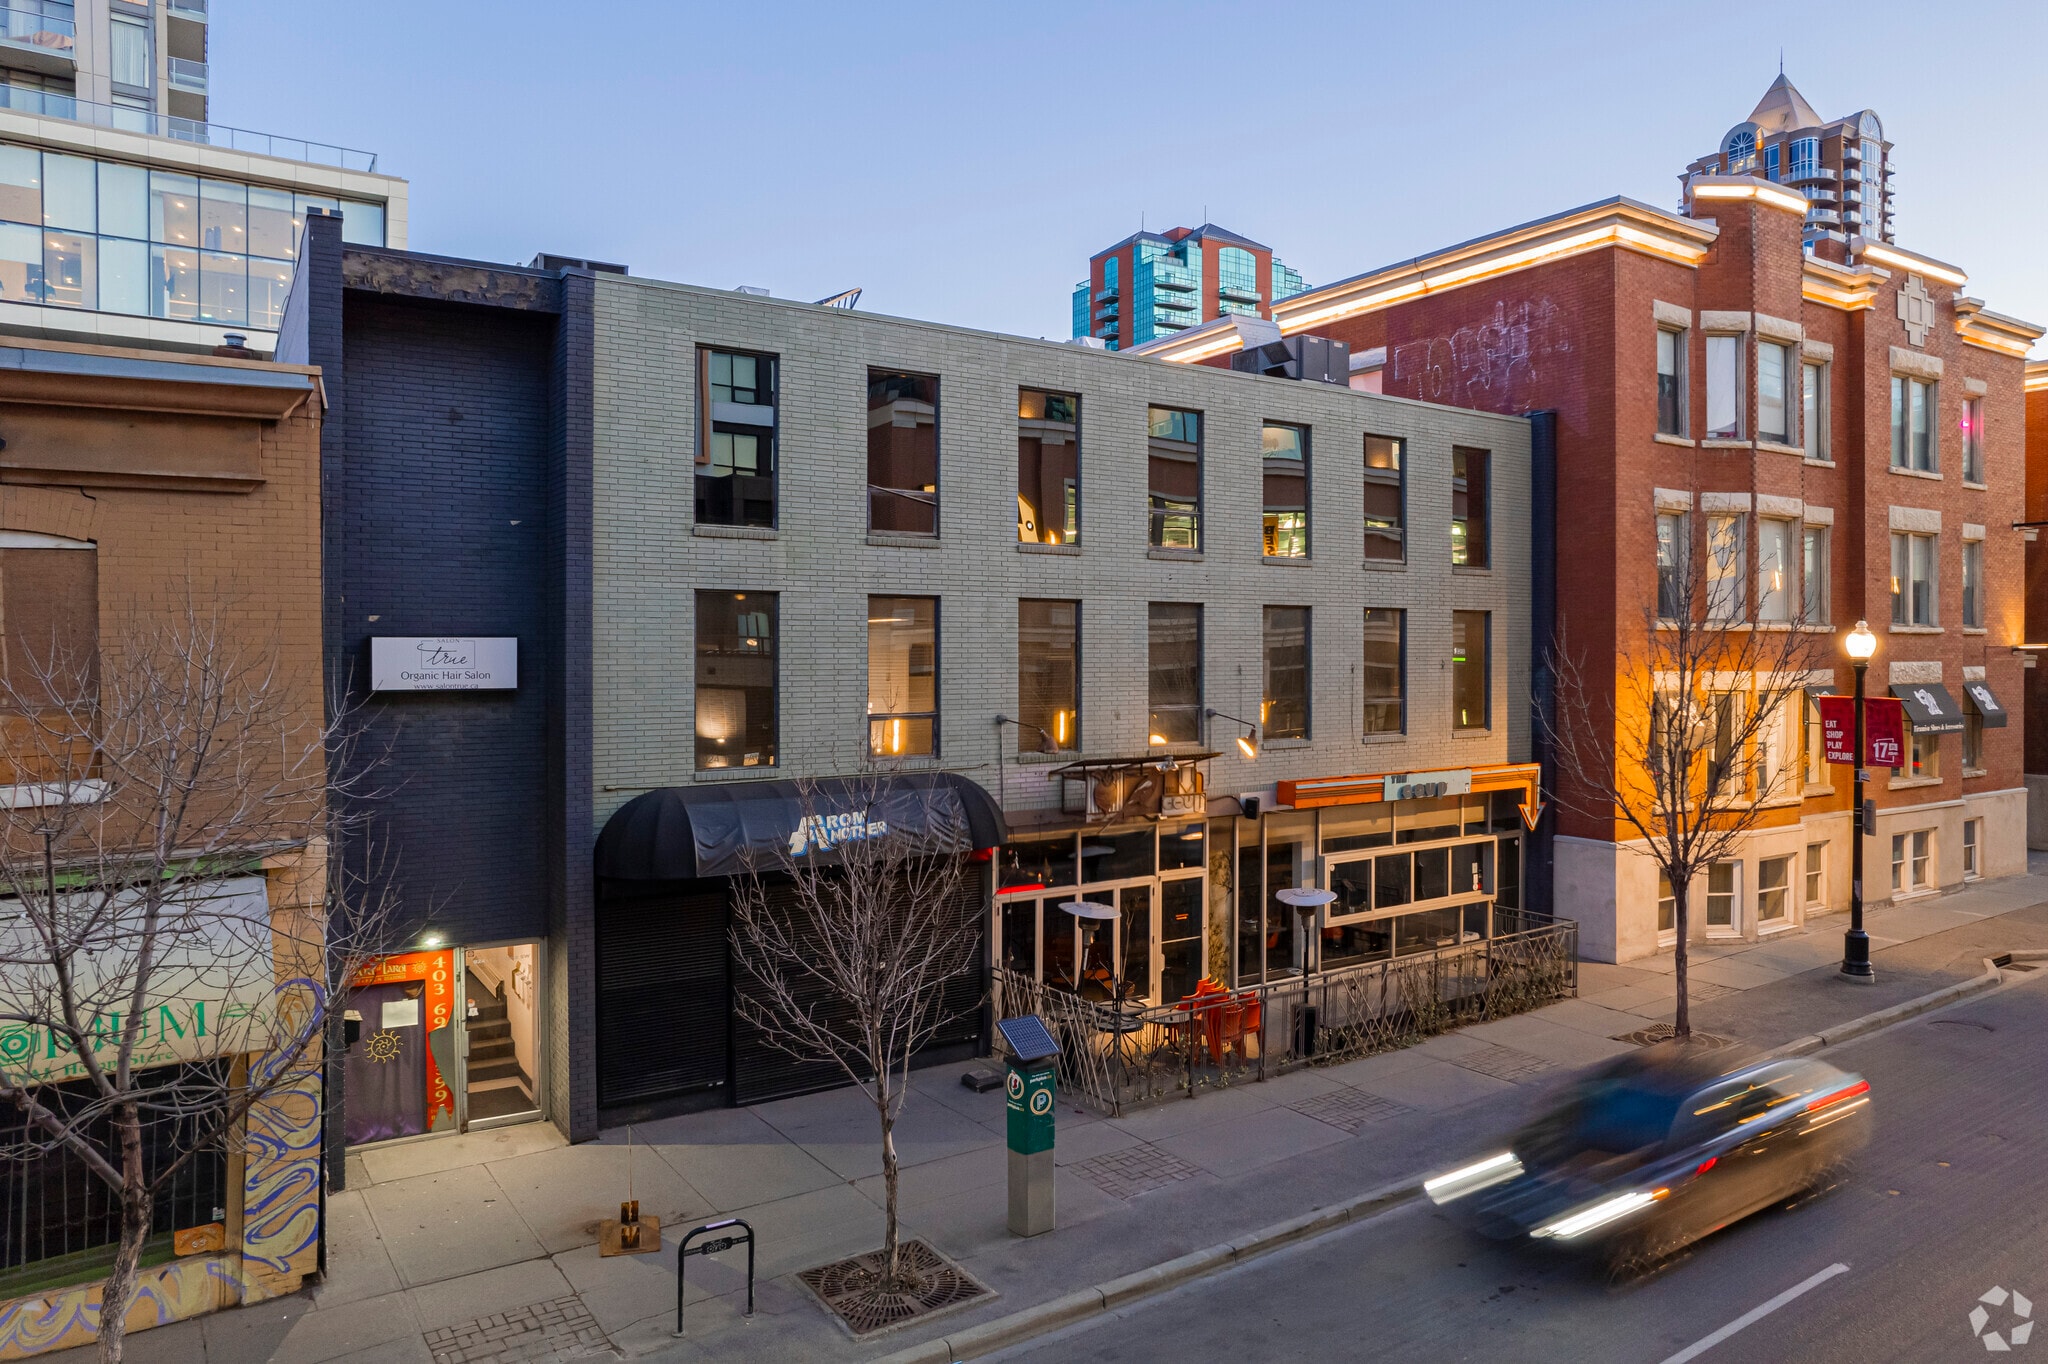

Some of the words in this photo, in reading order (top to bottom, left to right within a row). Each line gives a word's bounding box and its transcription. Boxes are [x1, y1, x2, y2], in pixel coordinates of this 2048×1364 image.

[400, 671, 439, 681] Organic
[442, 671, 461, 680] Hair
[464, 671, 491, 680] Salon
[1825, 720, 1837, 729] EAT
[1826, 730, 1843, 739] SHOP
[1827, 741, 1842, 749] PLAY
[1873, 742, 1888, 758] 17
[1828, 752, 1854, 761] EXPLORE
